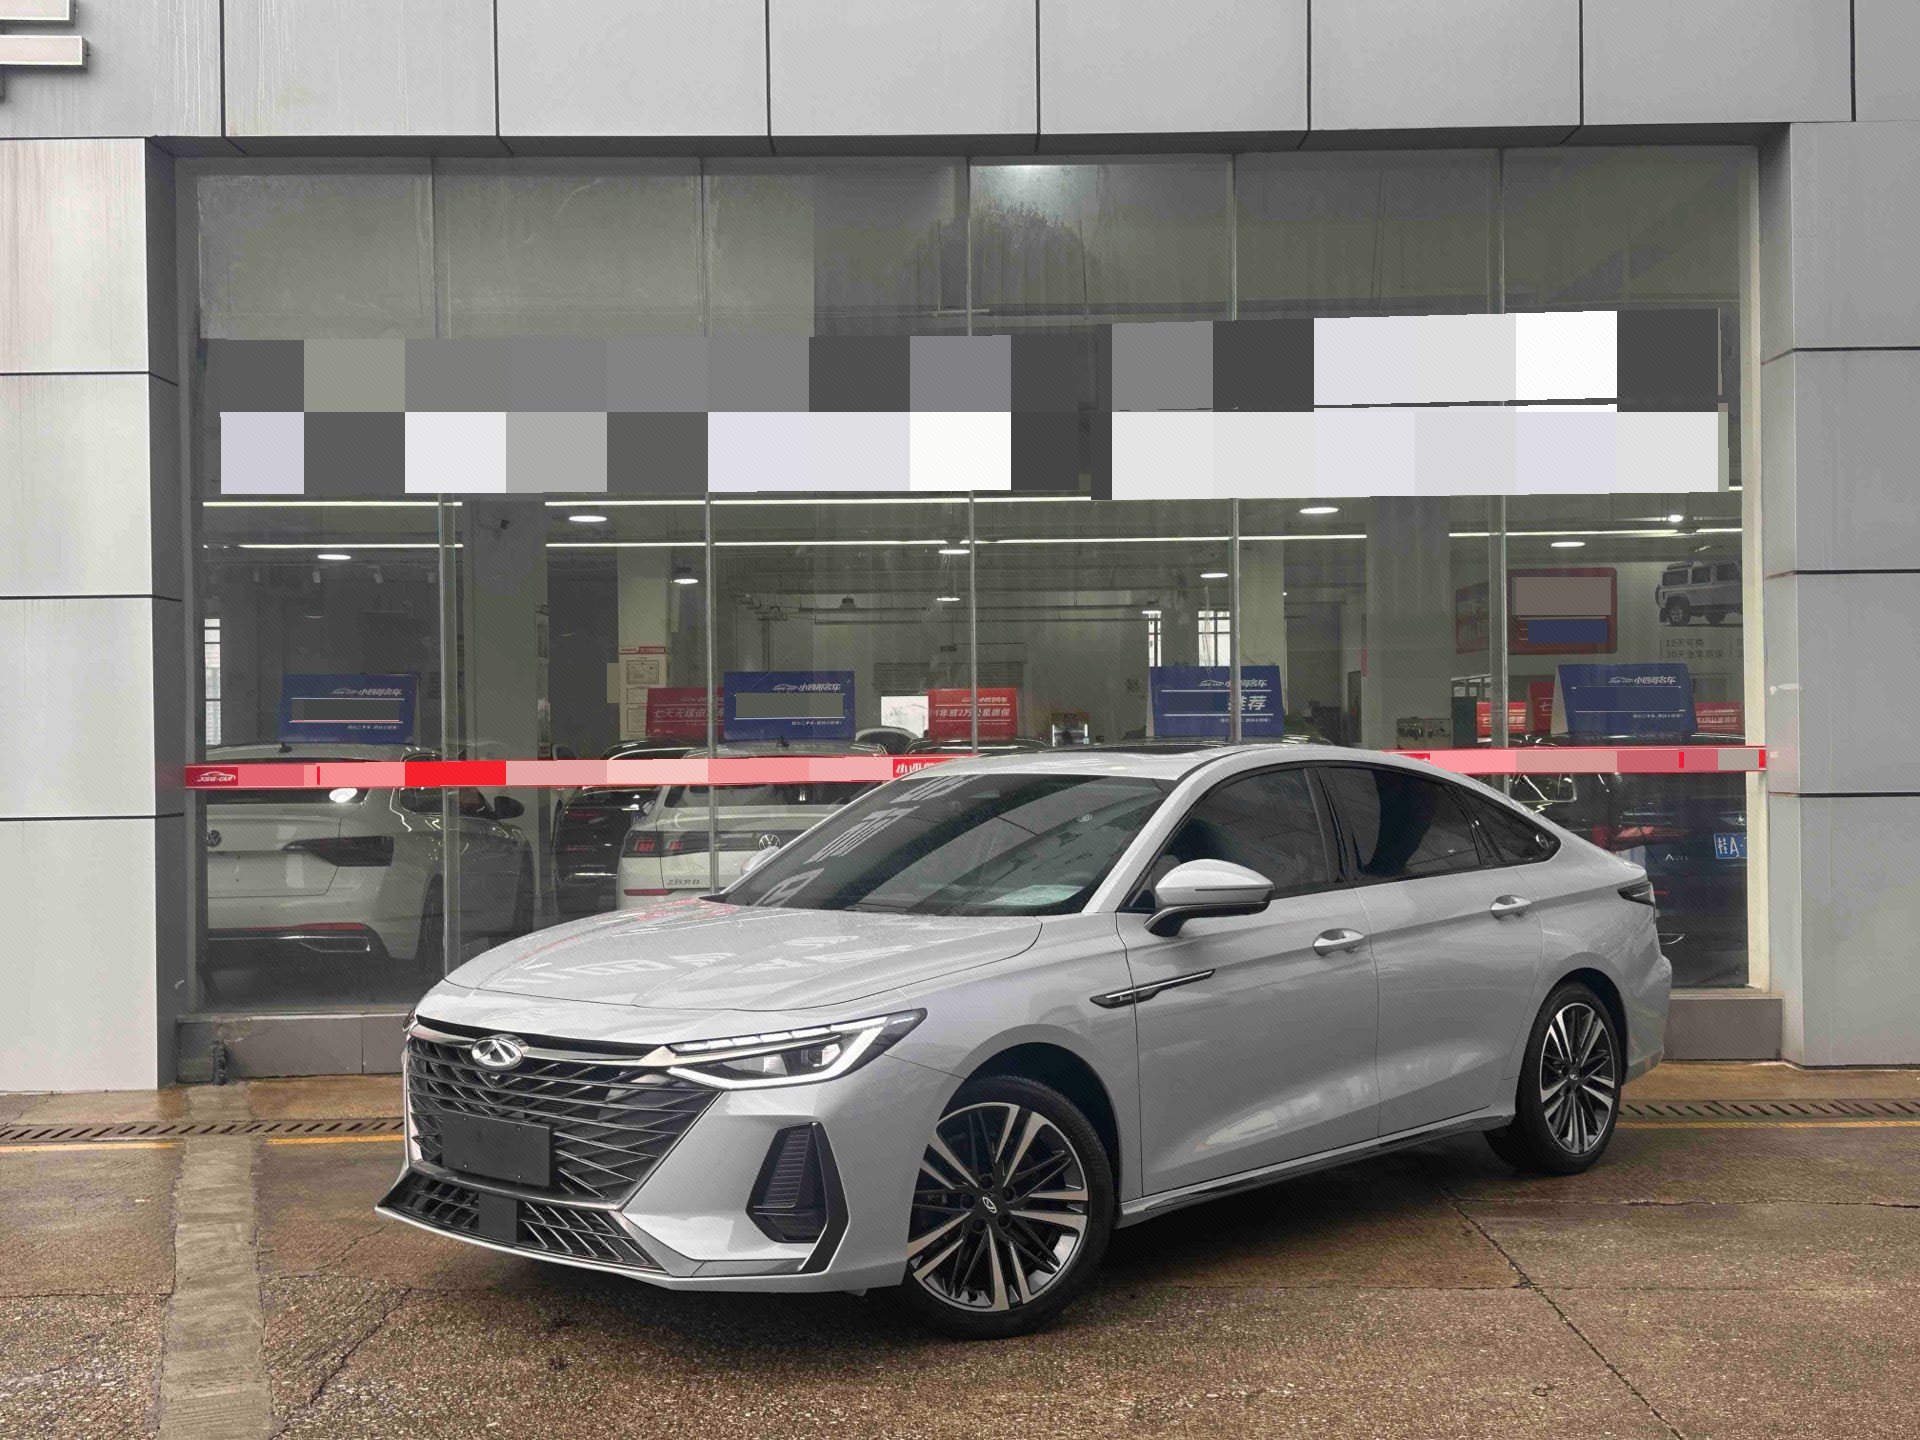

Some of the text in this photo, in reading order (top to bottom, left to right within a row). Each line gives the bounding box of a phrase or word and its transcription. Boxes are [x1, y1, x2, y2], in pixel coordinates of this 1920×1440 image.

[655, 708, 724, 718] 七天无理由车
